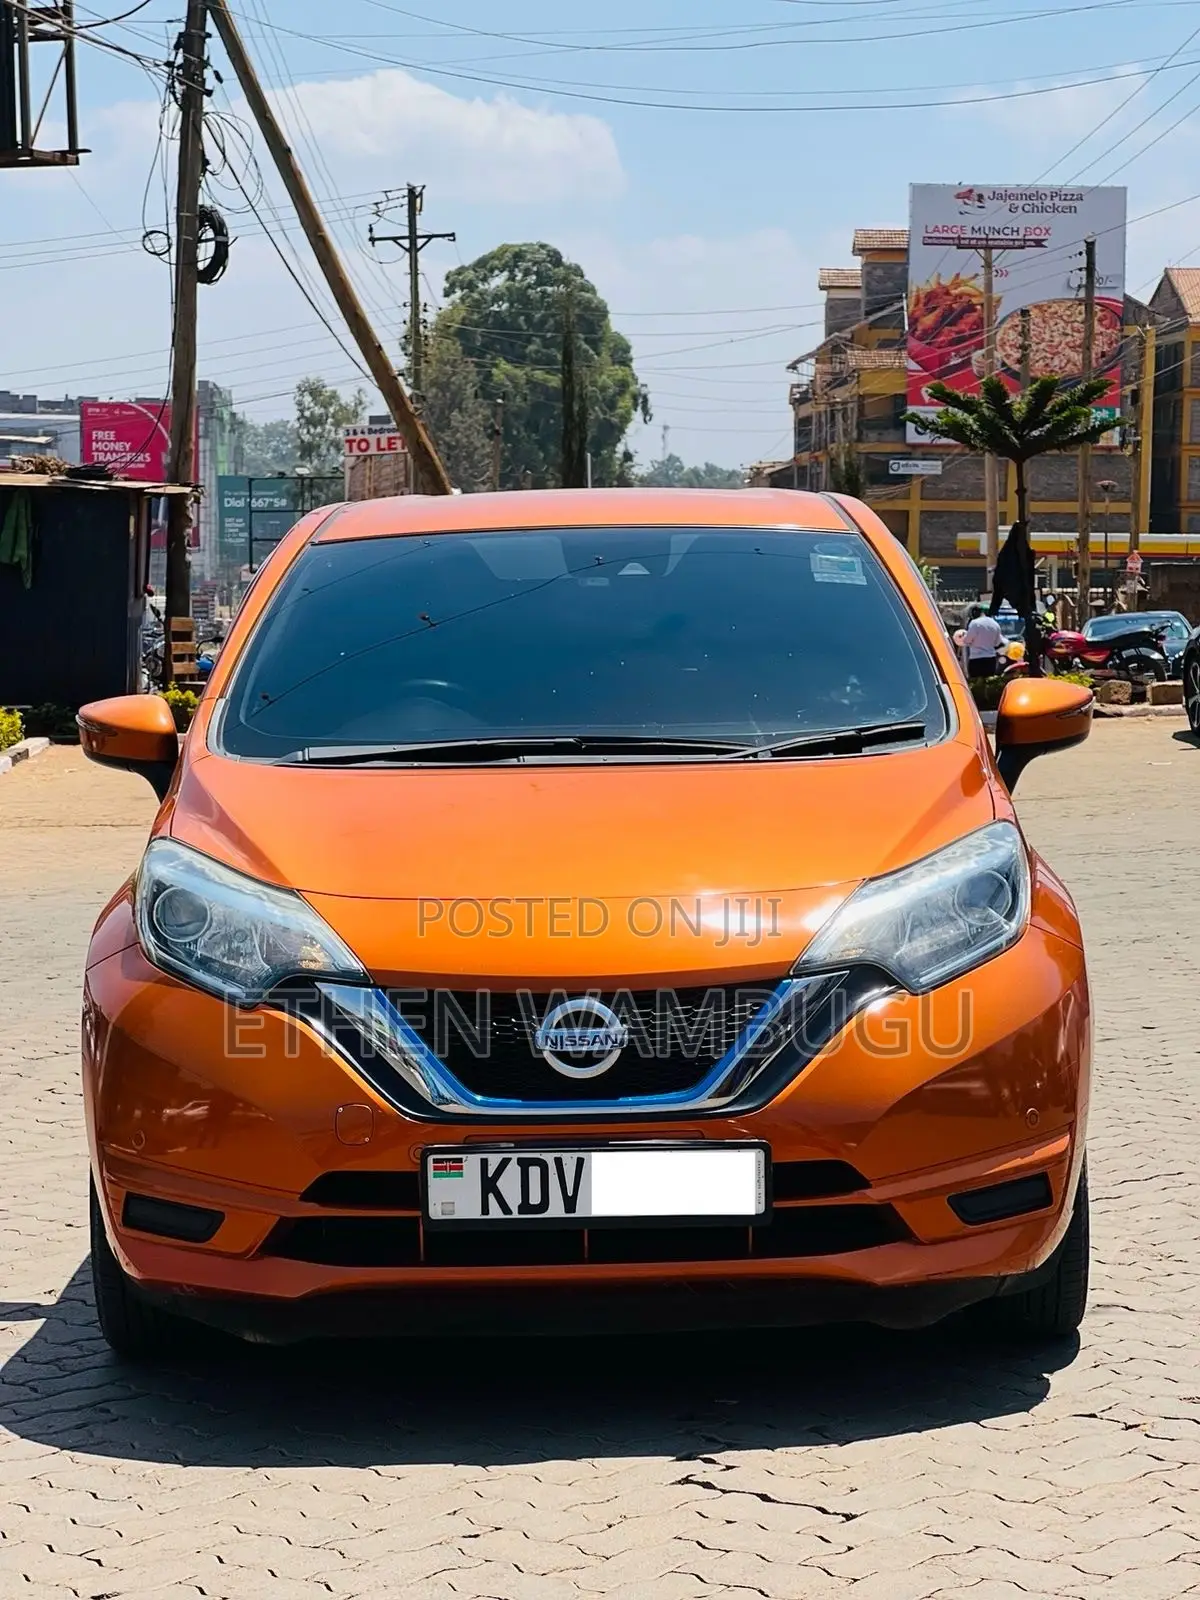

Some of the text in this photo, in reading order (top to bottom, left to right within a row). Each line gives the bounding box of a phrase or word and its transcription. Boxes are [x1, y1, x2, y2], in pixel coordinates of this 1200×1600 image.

[988, 190, 1084, 204] Jajemelo Pizza
[1009, 203, 1078, 214] & Chicken
[925, 225, 1052, 237] LARGE MUNCH BOX
[92, 431, 116, 441] FREE
[92, 442, 132, 451] MONEY
[345, 436, 405, 453] TO LET
[92, 452, 151, 463] TRANSFERS
[224, 498, 245, 507] Dial
[544, 1033, 618, 1050] NISSAN
[480, 1156, 585, 1216] KDV
